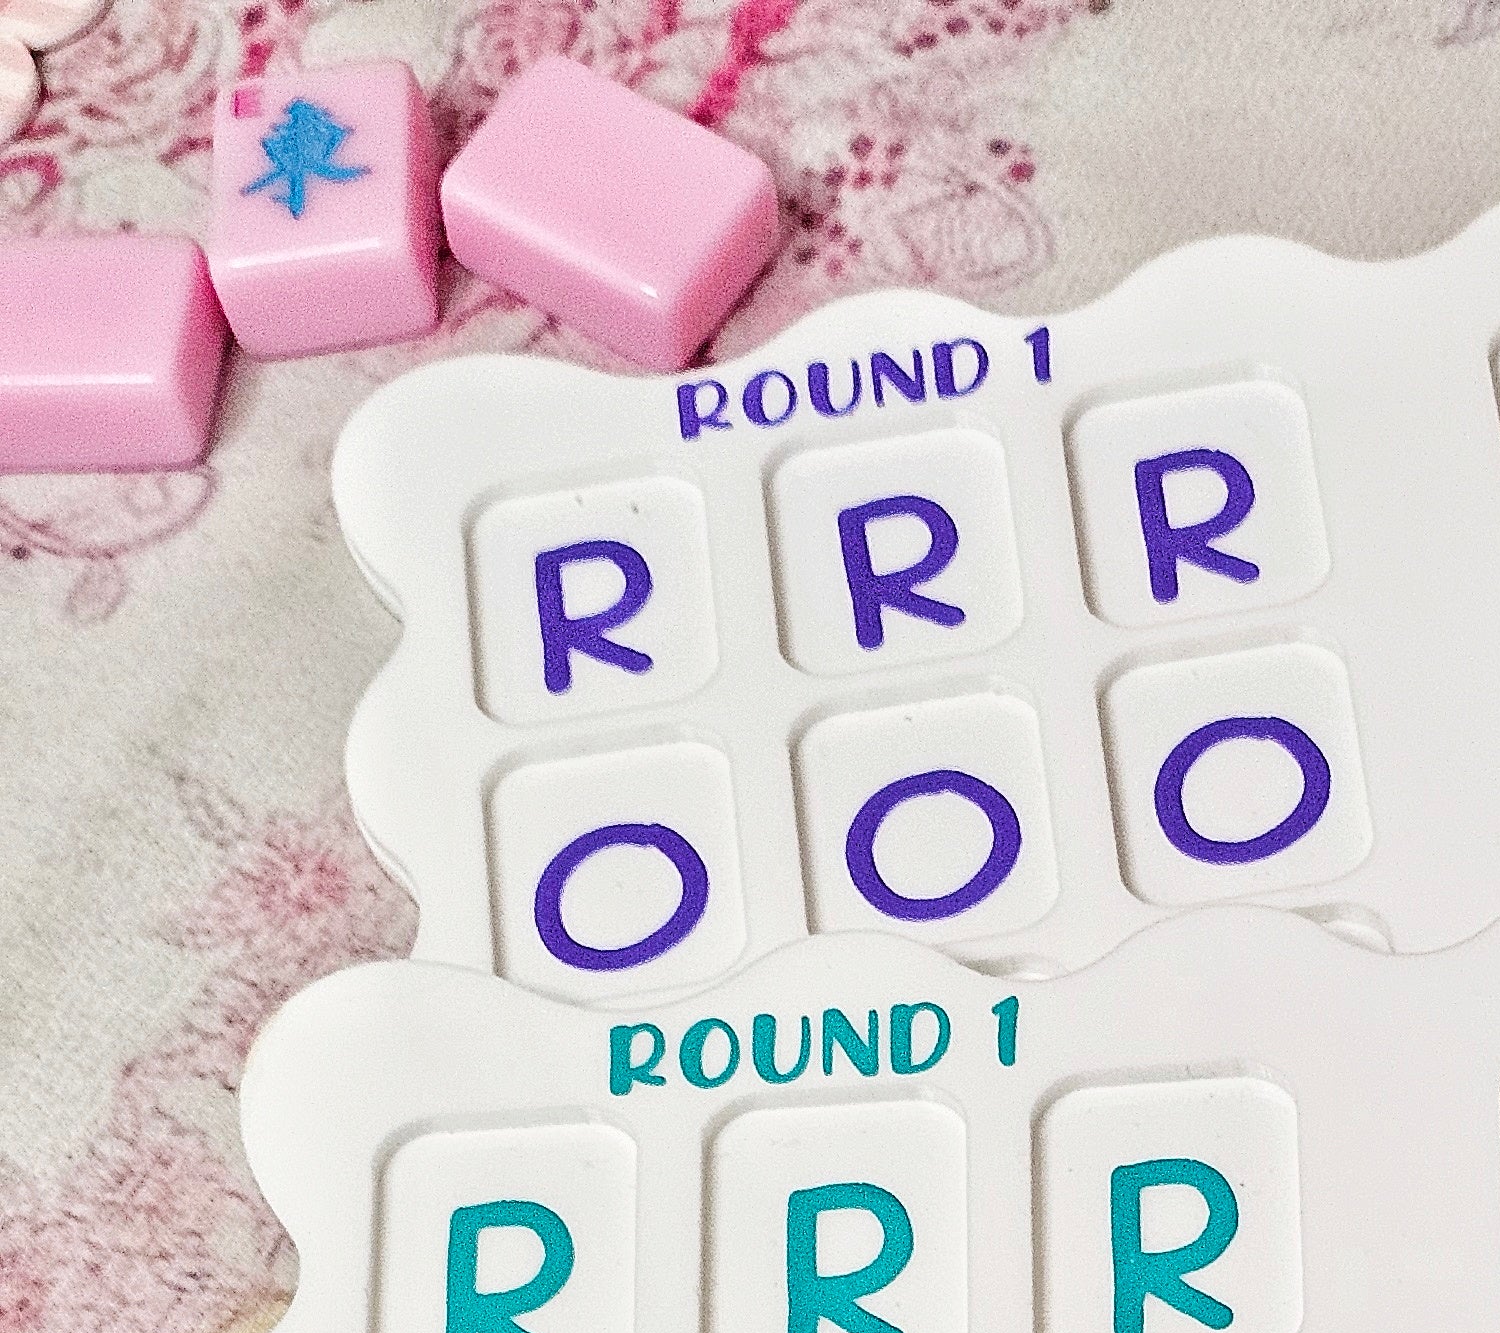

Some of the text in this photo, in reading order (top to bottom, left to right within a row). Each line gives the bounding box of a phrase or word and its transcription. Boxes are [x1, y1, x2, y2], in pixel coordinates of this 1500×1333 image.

[675, 327, 1050, 438] ROUND 1
[535, 449, 1259, 692] R R R
[534, 717, 1330, 970] O O O
[610, 996, 1019, 1095] ROUND 1
